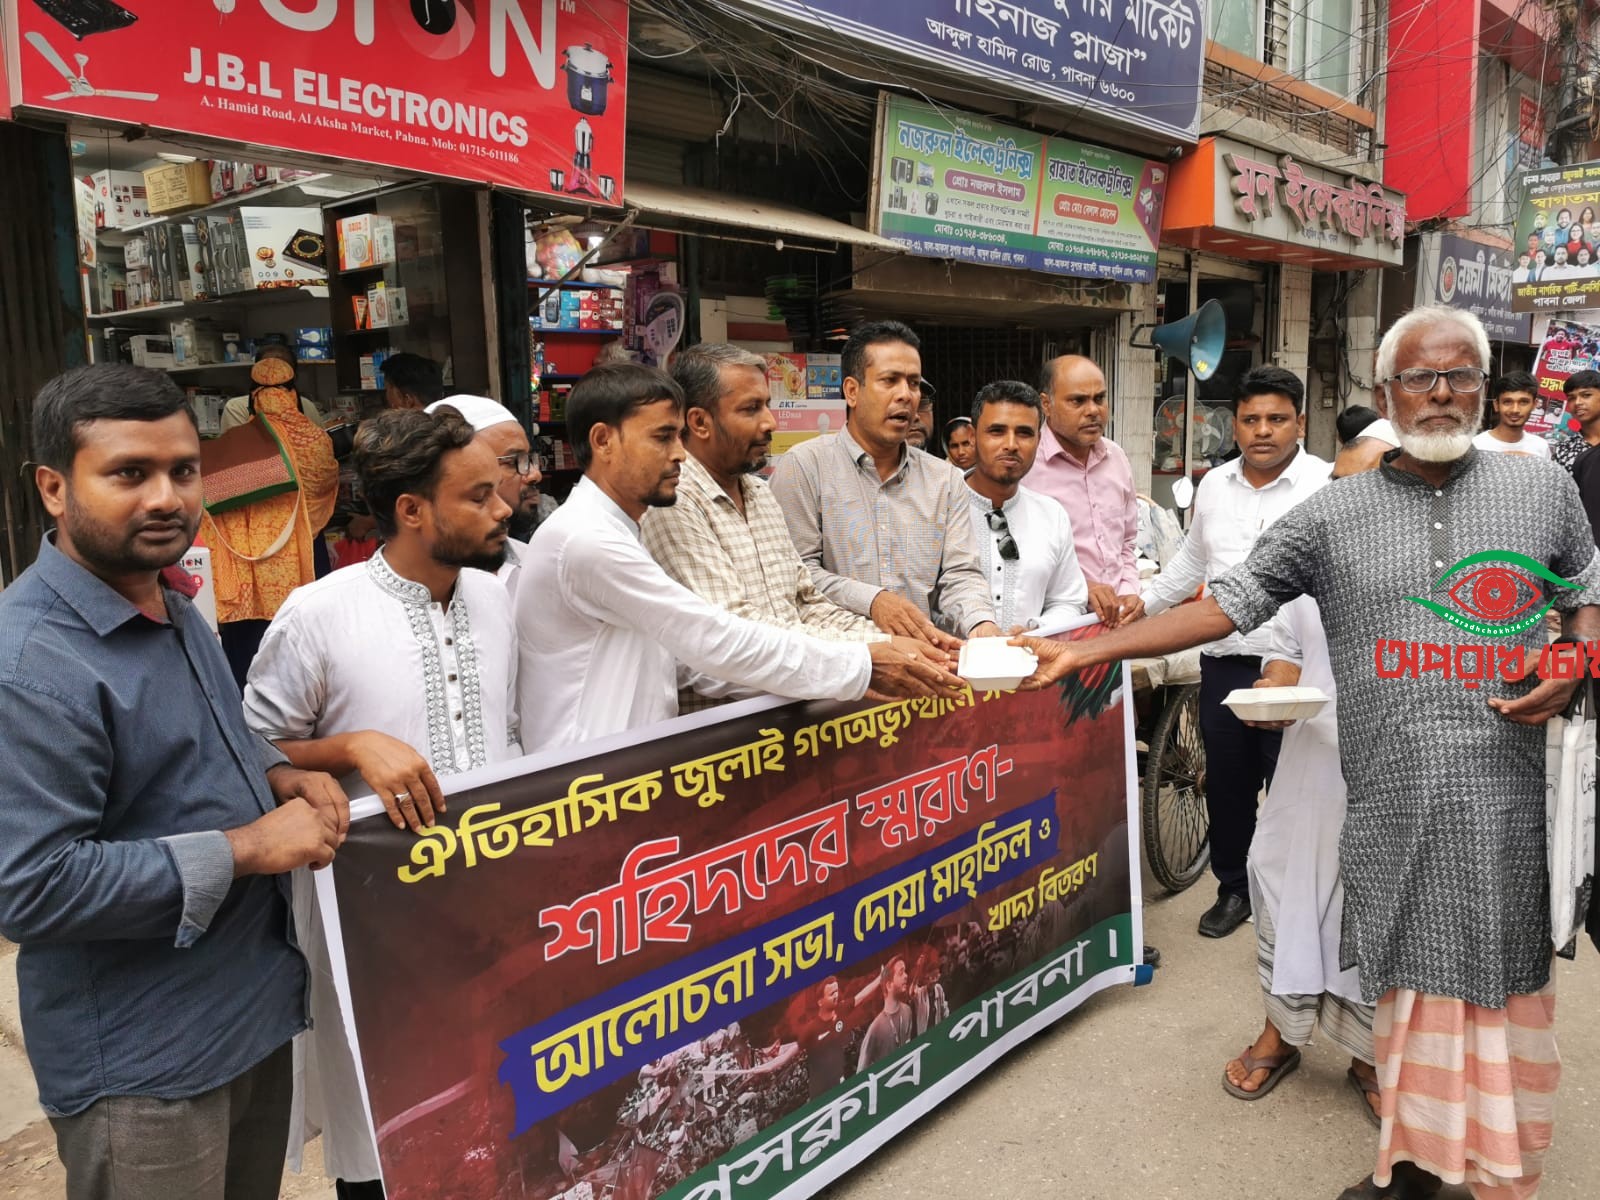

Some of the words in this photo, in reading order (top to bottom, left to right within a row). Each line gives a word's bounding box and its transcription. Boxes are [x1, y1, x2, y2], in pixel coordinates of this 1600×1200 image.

[184, 47, 282, 99] J.B.L
[294, 68, 528, 147] ELECTRONICS
[925, 18, 972, 50] আব্দুল
[977, 35, 1018, 64] হামিদ
[1061, 66, 1097, 91] পাবনা
[1099, 79, 1136, 102] ৬৬০০
[200, 96, 214, 108] A.
[218, 97, 259, 115] Hamid
[262, 105, 296, 122] Road,
[298, 112, 311, 124] Al
[314, 116, 348, 131] Aksha
[351, 121, 393, 141] Market,
[432, 137, 457, 151] Mob:
[459, 144, 519, 164] 01715-611186
[898, 120, 953, 157] নজরুল
[1048, 157, 1078, 184] রাহাত
[1229, 153, 1282, 222] মুন
[1533, 297, 1559, 307] পাবনা
[1562, 294, 1586, 306] জেলা
[1540, 377, 1567, 392] শ্রদ্ধা
[397, 770, 662, 884] ঐতিহাসিক
[671, 728, 785, 808] জুলাই
[539, 799, 849, 965] শহিদদের
[988, 887, 1035, 932] খাদ্য
[1039, 852, 1098, 908] বিতরণ
[531, 948, 756, 1094] আলোচনা
[763, 911, 844, 986] সভা,
[854, 870, 926, 942] দোয়া
[949, 939, 1092, 1042] পাবনা
